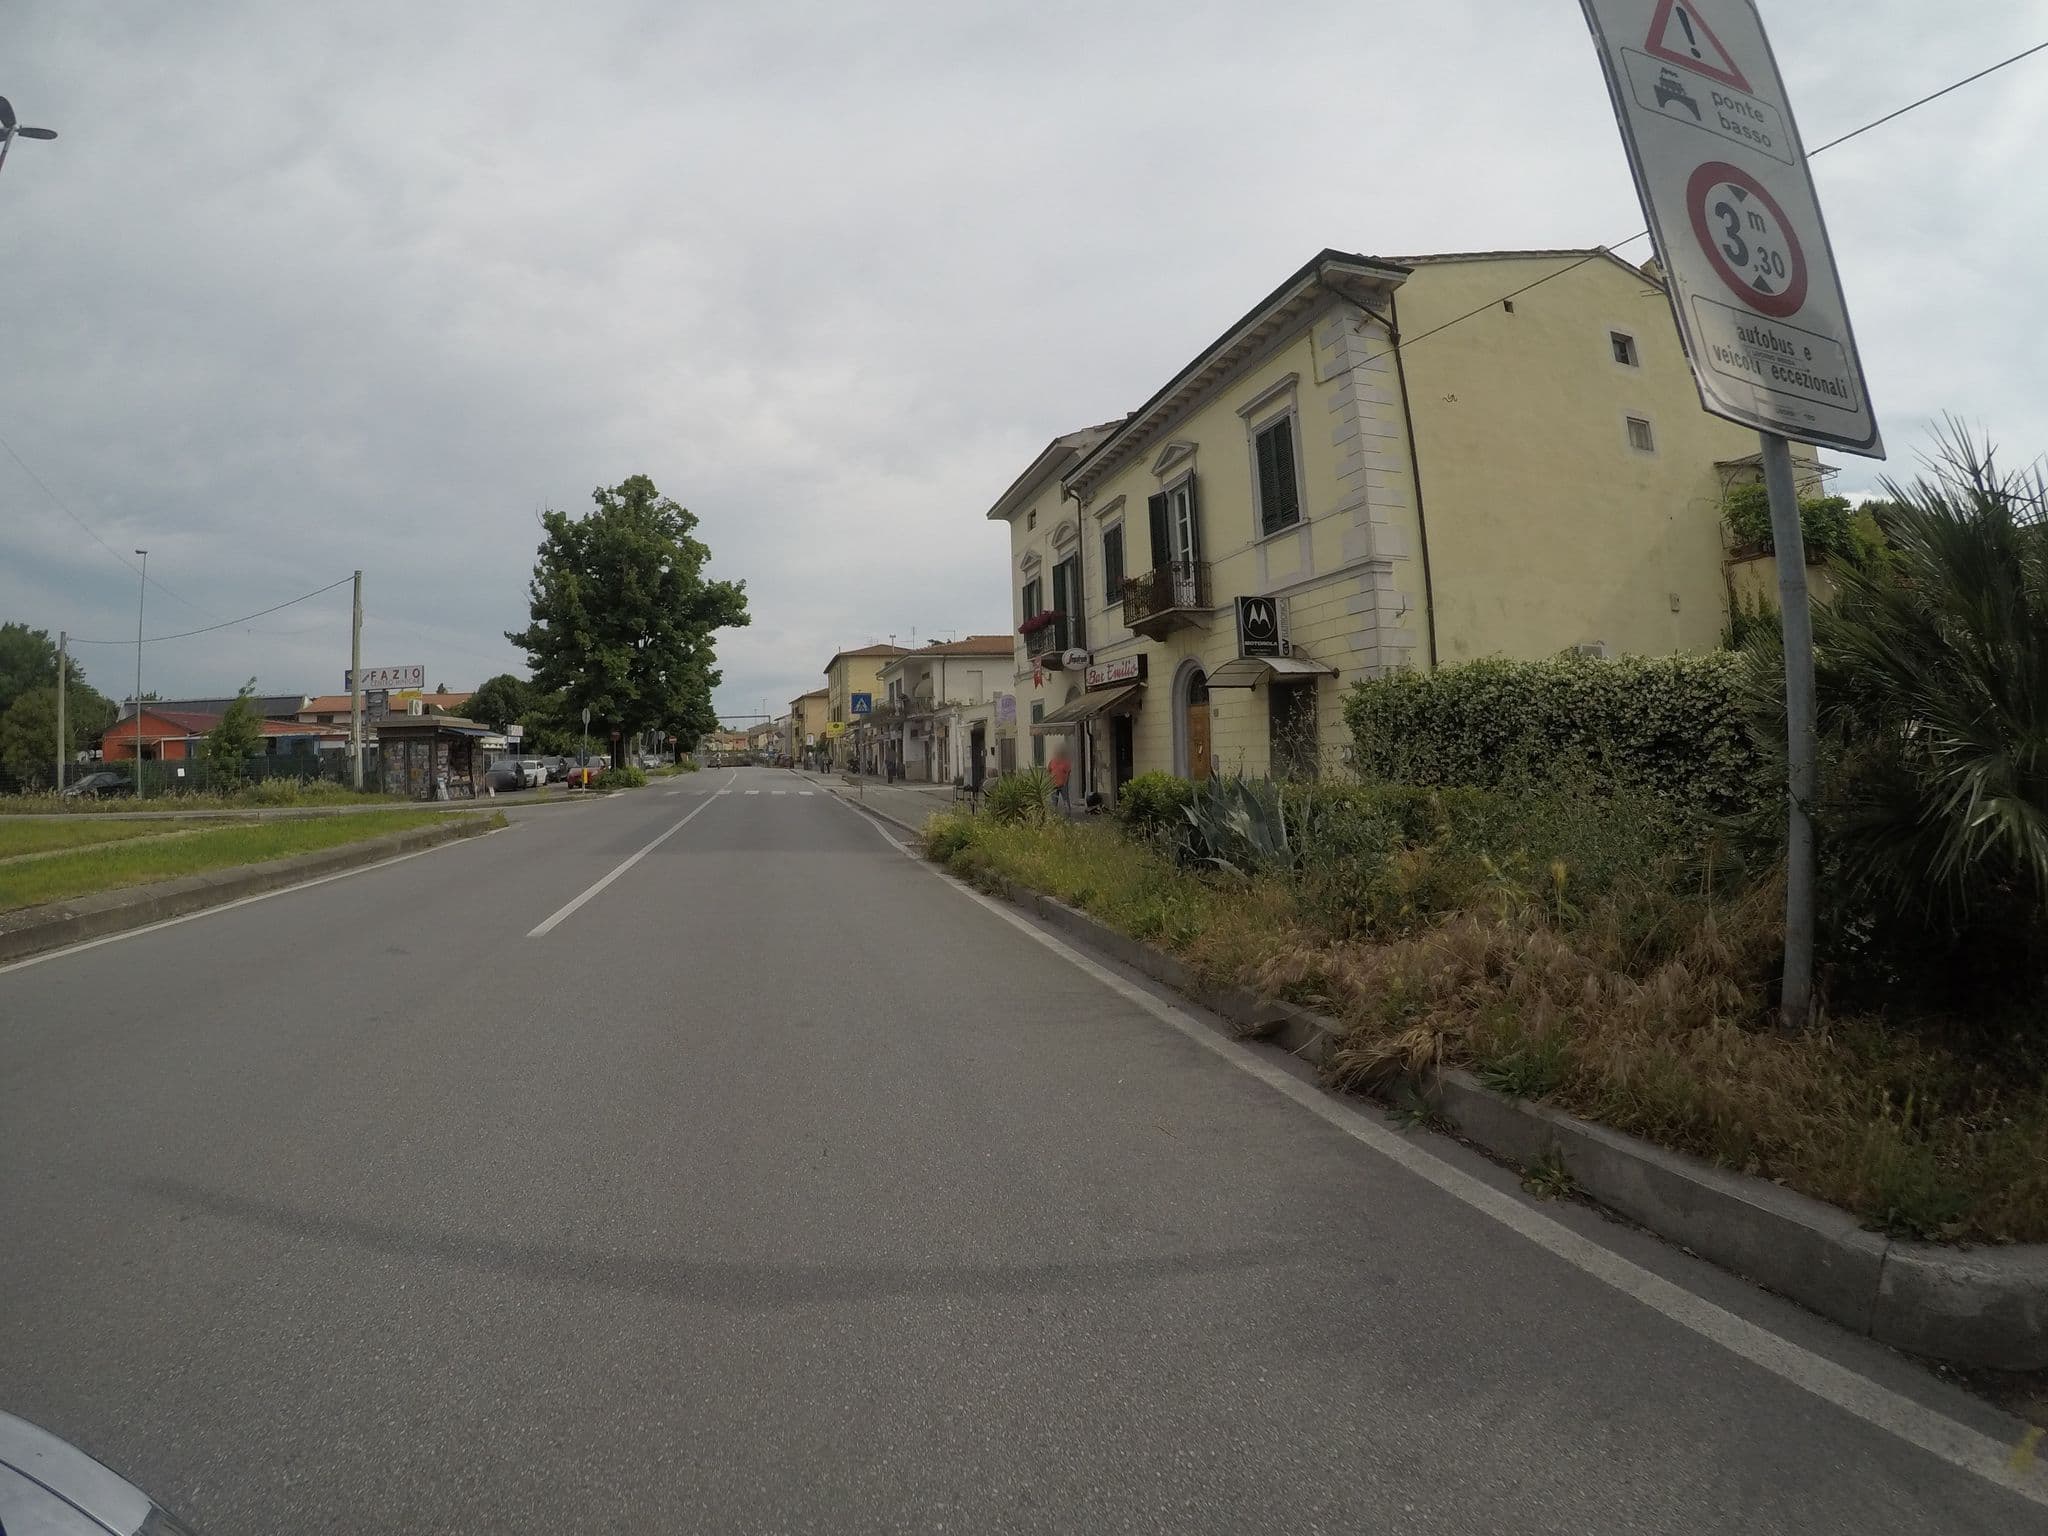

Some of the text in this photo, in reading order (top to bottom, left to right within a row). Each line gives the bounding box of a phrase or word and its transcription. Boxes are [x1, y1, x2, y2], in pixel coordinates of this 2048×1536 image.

[1711, 91, 1765, 123] ponte
[1718, 112, 1772, 148] basso
[1737, 326, 1795, 356] autobus
[1804, 347, 1812, 361] e
[1713, 345, 1848, 399] veicoli eccezionali
[371, 669, 420, 680] FAZIO
[1088, 660, 1138, 684] Bar Emilio
